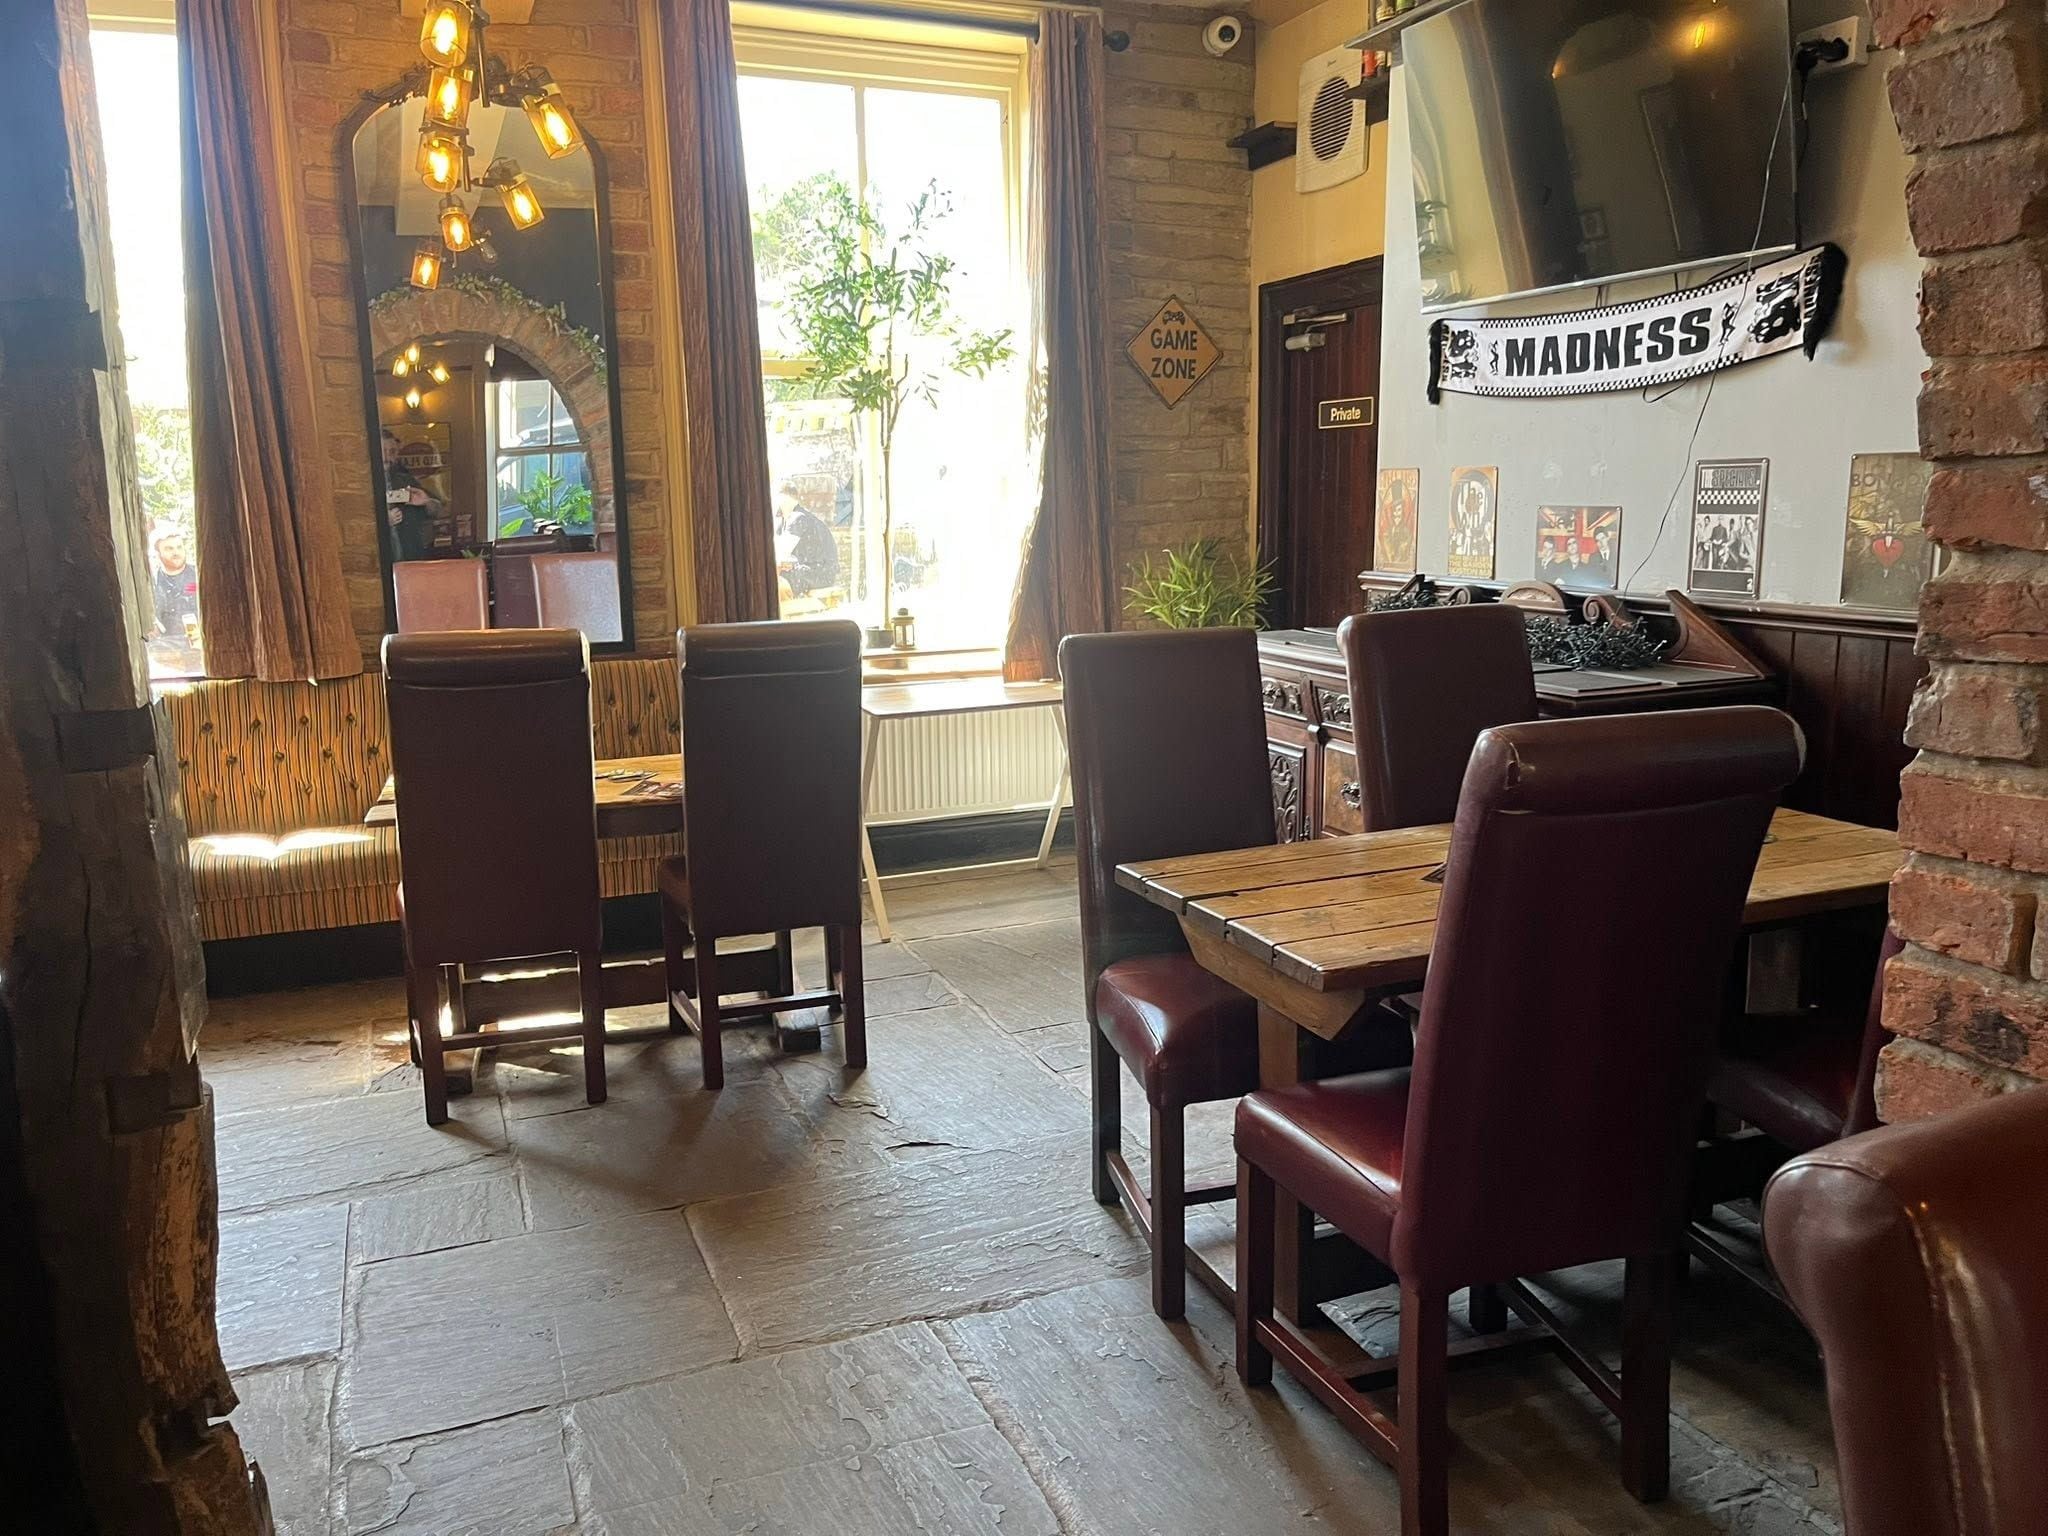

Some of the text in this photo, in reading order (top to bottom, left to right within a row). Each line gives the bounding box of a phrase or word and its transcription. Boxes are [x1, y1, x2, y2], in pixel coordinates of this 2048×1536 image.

[1150, 328, 1198, 351] GAME
[1505, 307, 1713, 377] MADNESS
[1151, 357, 1197, 380] ZONE
[1330, 406, 1361, 422] Private
